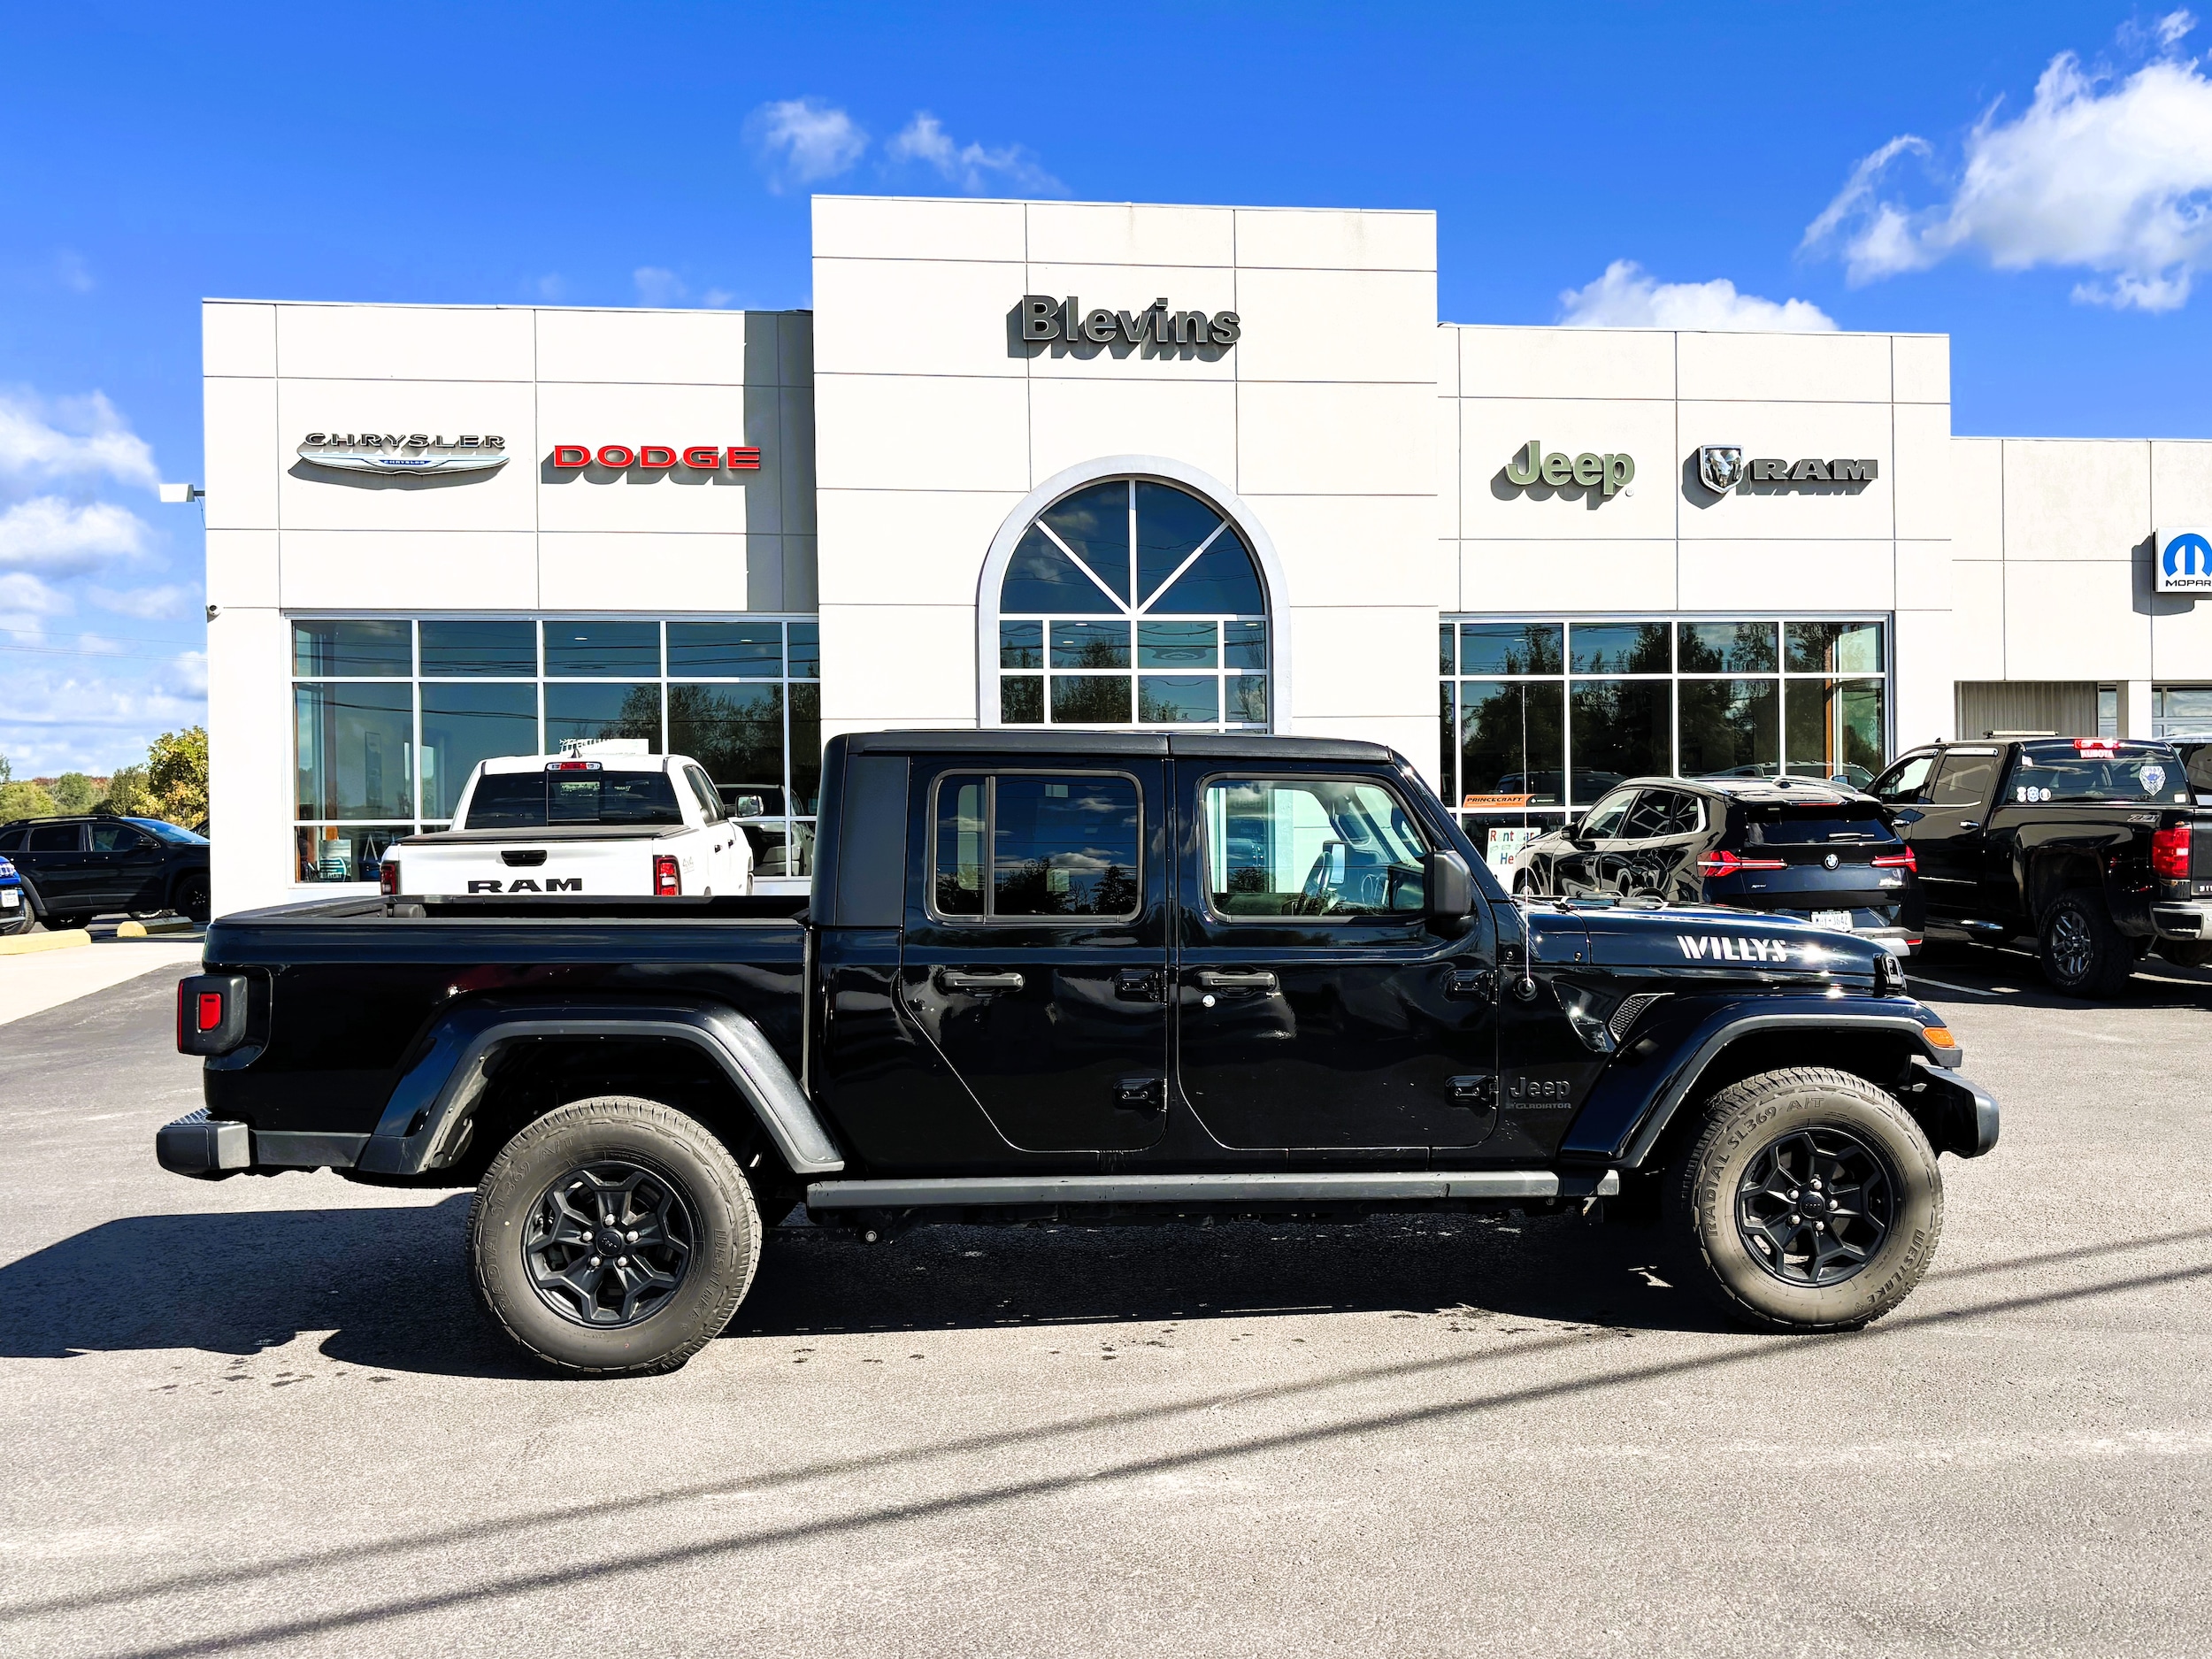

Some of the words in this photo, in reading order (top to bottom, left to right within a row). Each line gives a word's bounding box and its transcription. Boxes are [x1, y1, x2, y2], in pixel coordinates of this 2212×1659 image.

[1022, 295, 1241, 344] Blevins
[304, 432, 505, 449] CHRYSLER
[553, 444, 761, 469] DODGE
[1505, 440, 1635, 495] Jeep
[1753, 458, 1878, 480] RAM
[2080, 749, 2115, 759] KUBOTA
[467, 878, 583, 894] RAM
[1676, 934, 1787, 962] WILLYS
[1509, 1077, 1571, 1100] Jeep
[537, 1135, 574, 1163] A/T
[1702, 1154, 1731, 1237] RADIAL
[1727, 1106, 1777, 1150] SL369
[1786, 1097, 1824, 1112] A/T
[1867, 1228, 1925, 1306] WESTLAKE
